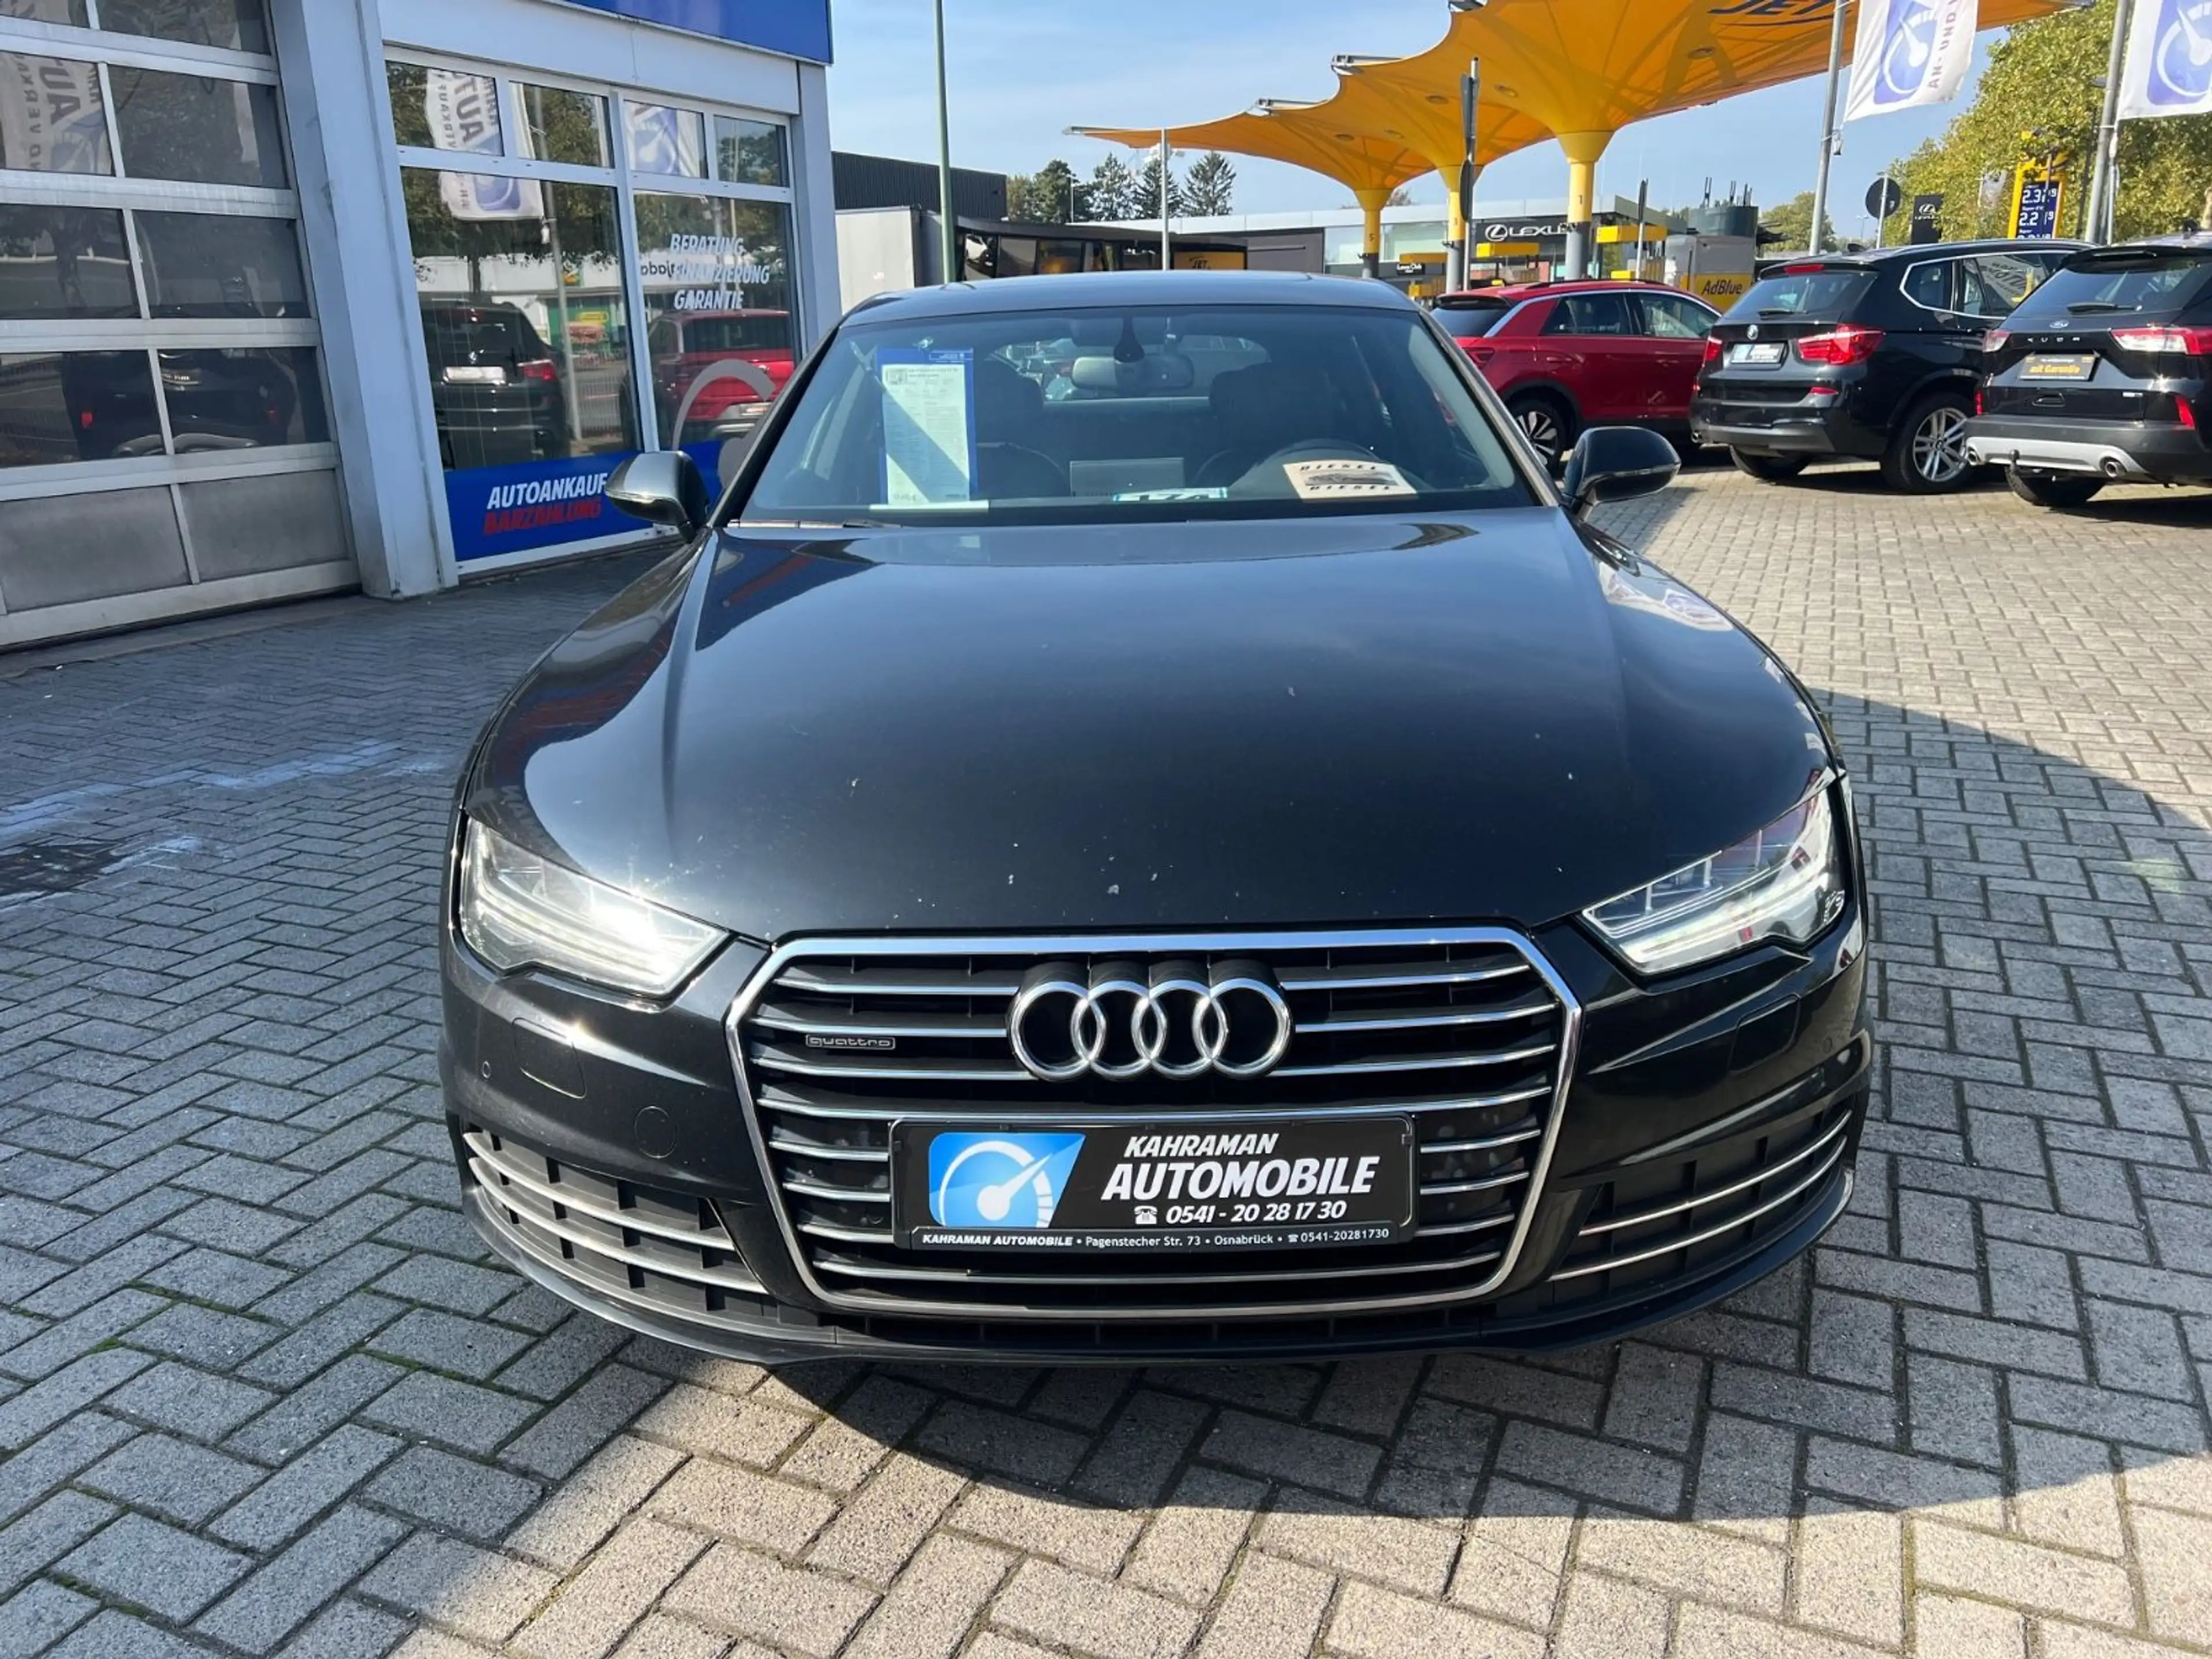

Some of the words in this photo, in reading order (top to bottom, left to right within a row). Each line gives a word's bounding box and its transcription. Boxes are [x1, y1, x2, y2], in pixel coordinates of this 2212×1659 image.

[1509, 225, 1568, 237] LEXU
[1701, 279, 1743, 296] AdBlue
[673, 289, 745, 310] GARANTIE
[486, 472, 608, 510] AUTOANKAUF
[809, 1037, 891, 1047] quattro
[1123, 1133, 1279, 1158] KAHRAMAN
[1100, 1156, 1380, 1200] AUTOMOBILE
[1165, 1205, 1215, 1224] 0541
[1230, 1203, 1260, 1222] 20
[1263, 1203, 1290, 1222] 28
[1294, 1202, 1317, 1220] 17
[1317, 1200, 1347, 1219] 30
[922, 1234, 991, 1245] KAHRAMAN
[993, 1235, 1074, 1246] AUTOMOBILE
[1085, 1236, 1161, 1248] Pagenstecher
[1164, 1236, 1183, 1247] Str.
[1187, 1236, 1201, 1246] 73
[1214, 1235, 1273, 1246] Osnabrück
[1300, 1228, 1389, 1243] 0541-20281730
